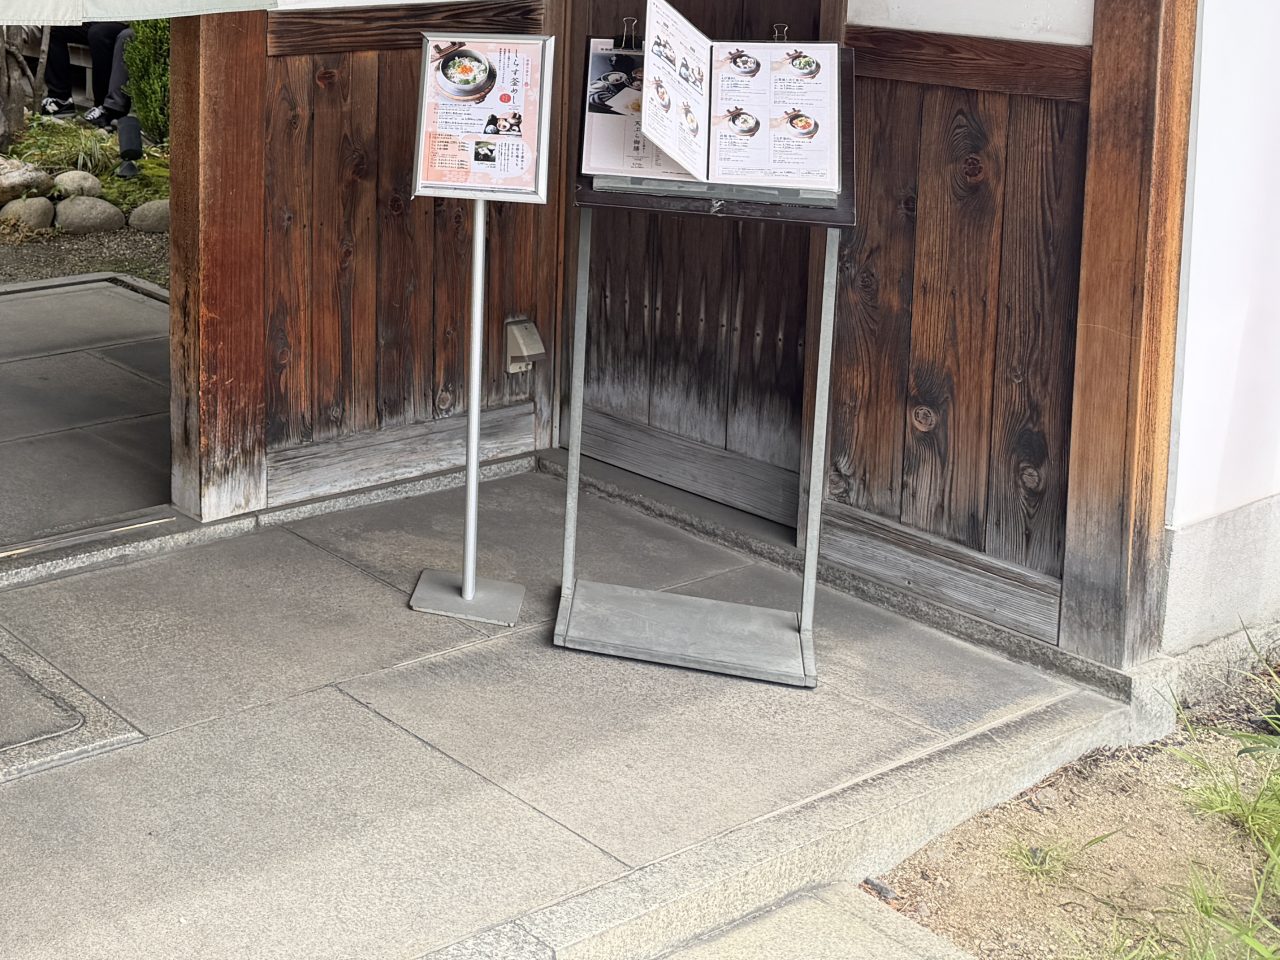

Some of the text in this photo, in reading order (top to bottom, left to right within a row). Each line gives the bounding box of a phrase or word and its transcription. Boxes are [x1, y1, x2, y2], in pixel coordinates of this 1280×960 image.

[510, 48, 520, 104] しらす釜めし
